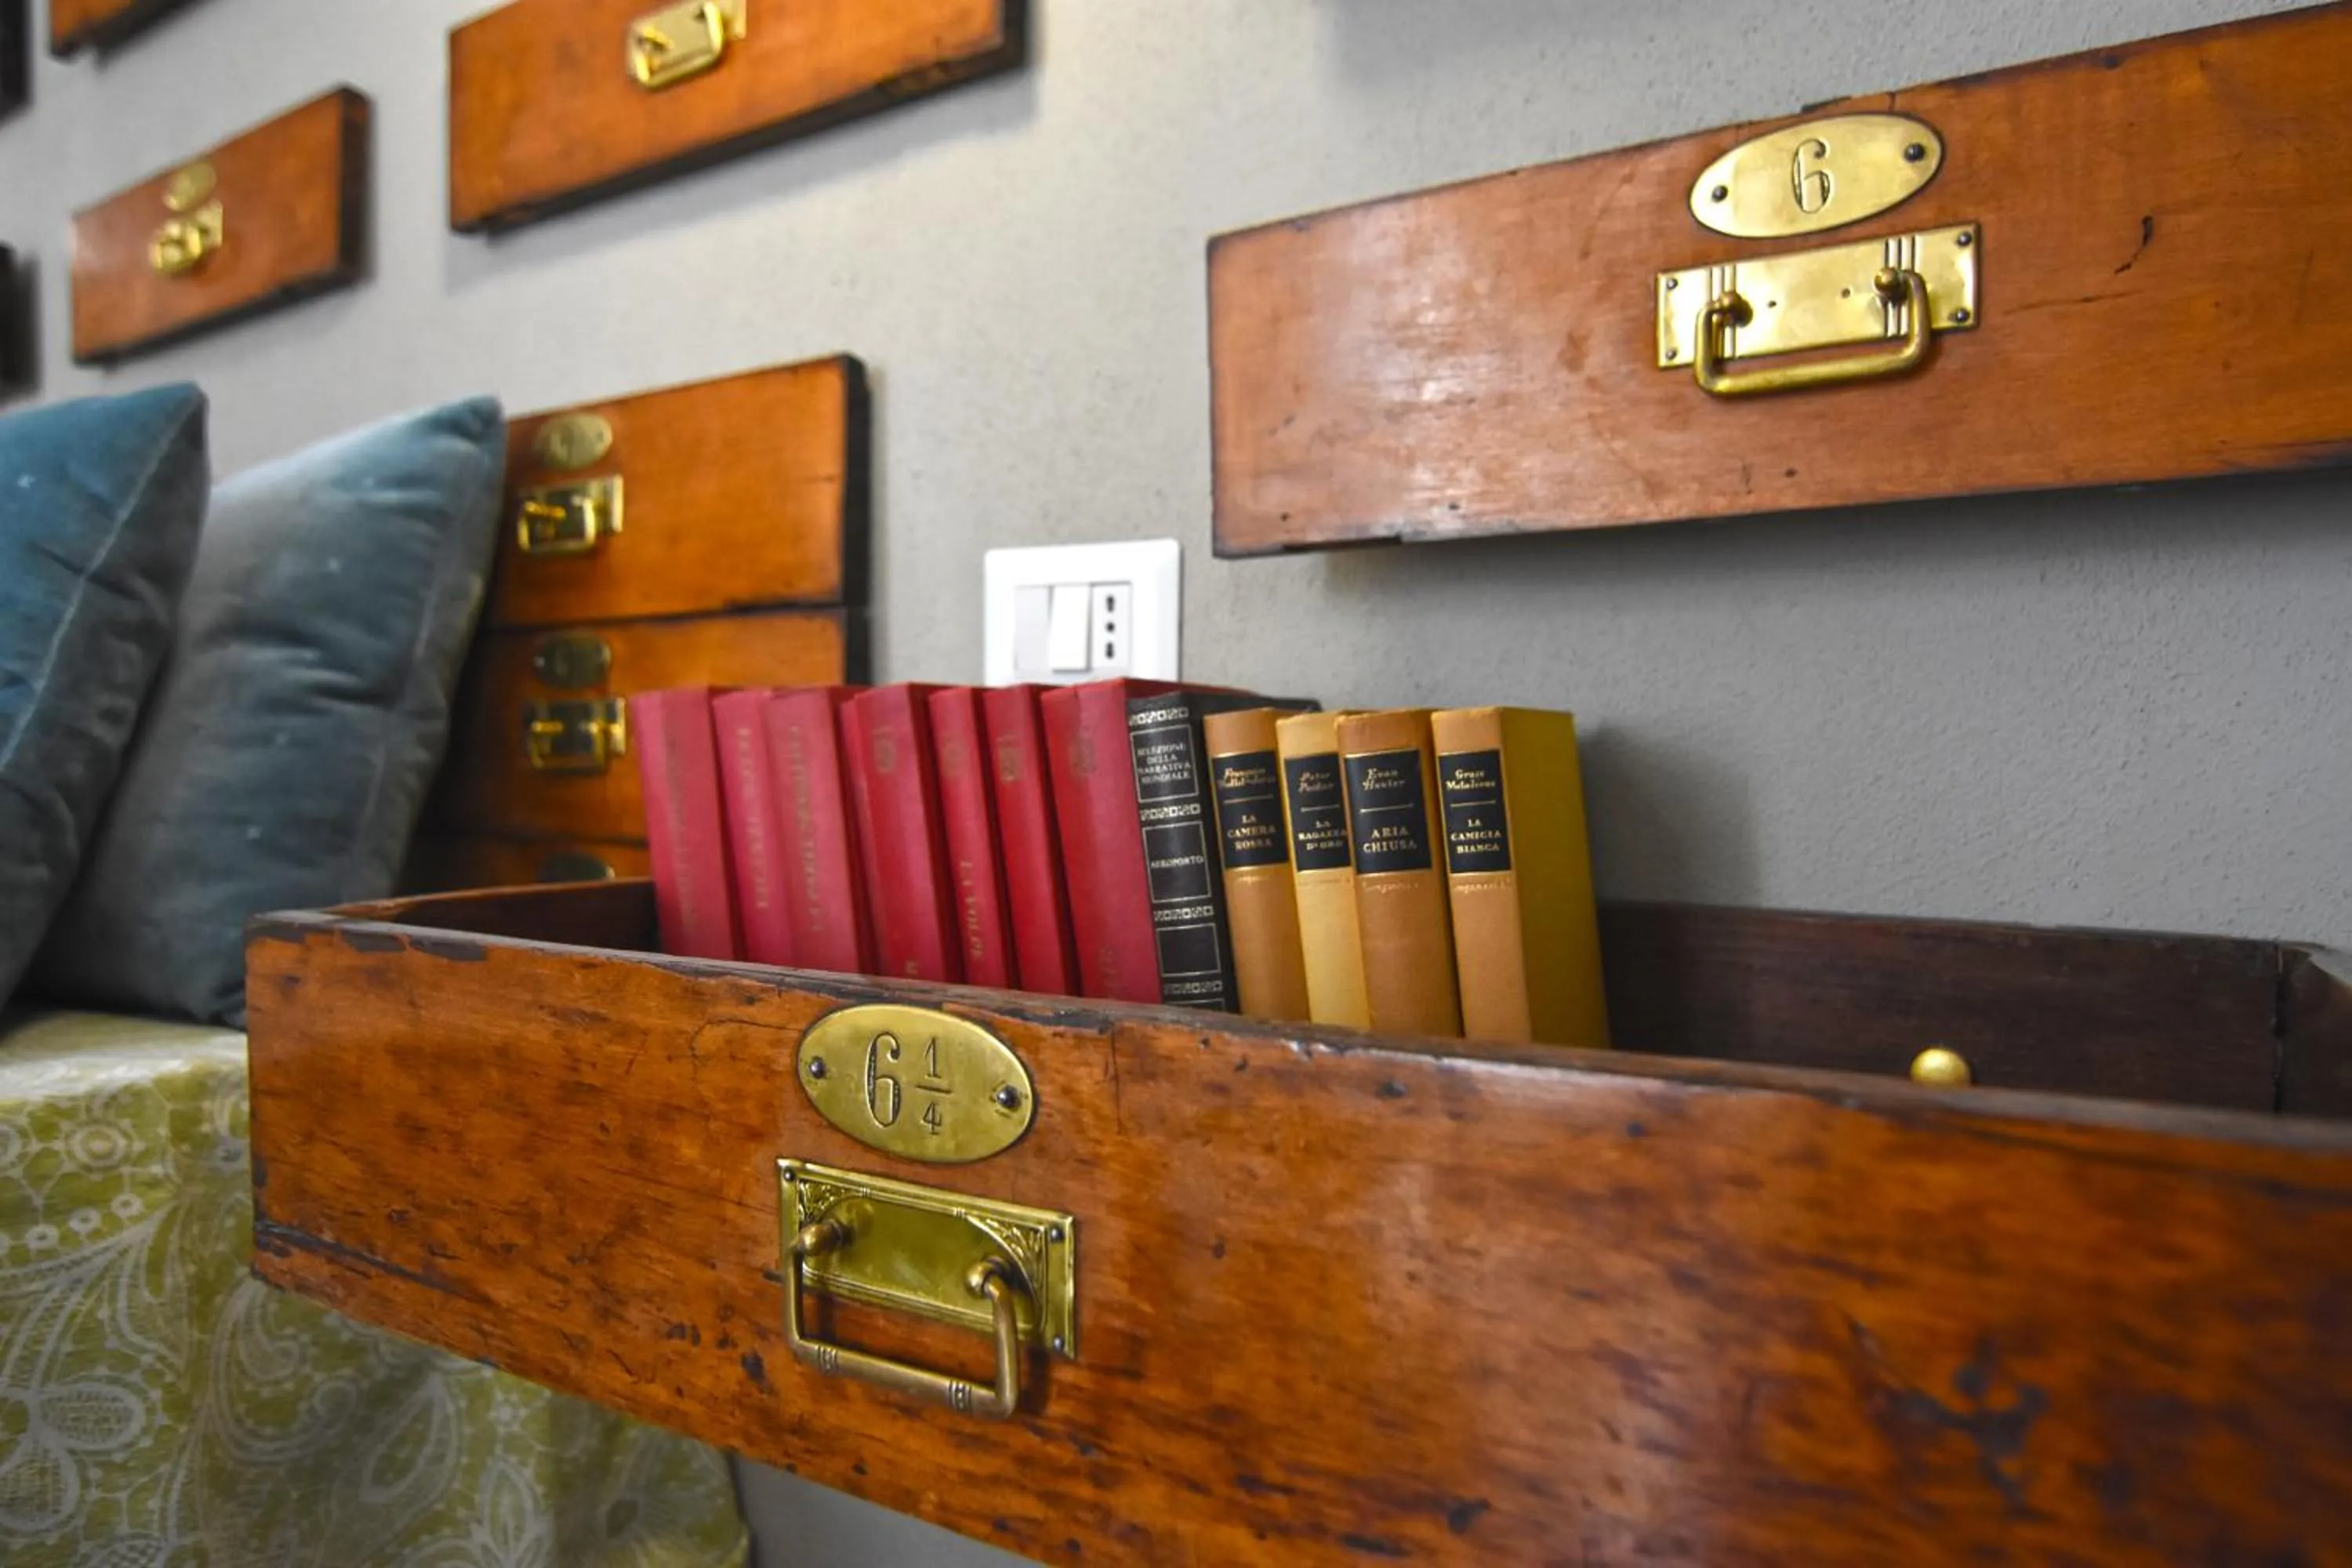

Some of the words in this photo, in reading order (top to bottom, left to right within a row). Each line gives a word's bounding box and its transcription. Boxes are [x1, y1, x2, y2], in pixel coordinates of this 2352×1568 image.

[1792, 139, 1831, 214] 6
[1147, 753, 1178, 764] DELLA
[1367, 768, 1399, 779] Evan
[1363, 779, 1405, 791] Hunter
[1242, 815, 1256, 823] LA
[1316, 820, 1331, 829] LA
[1228, 826, 1276, 838] CAMERA
[1372, 826, 1409, 839] ARIA
[1451, 829, 1501, 841] CAMICIA
[1363, 840, 1417, 853] CHIUSA
[1456, 843, 1500, 853] BIANCA
[865, 1032, 902, 1128] 6
